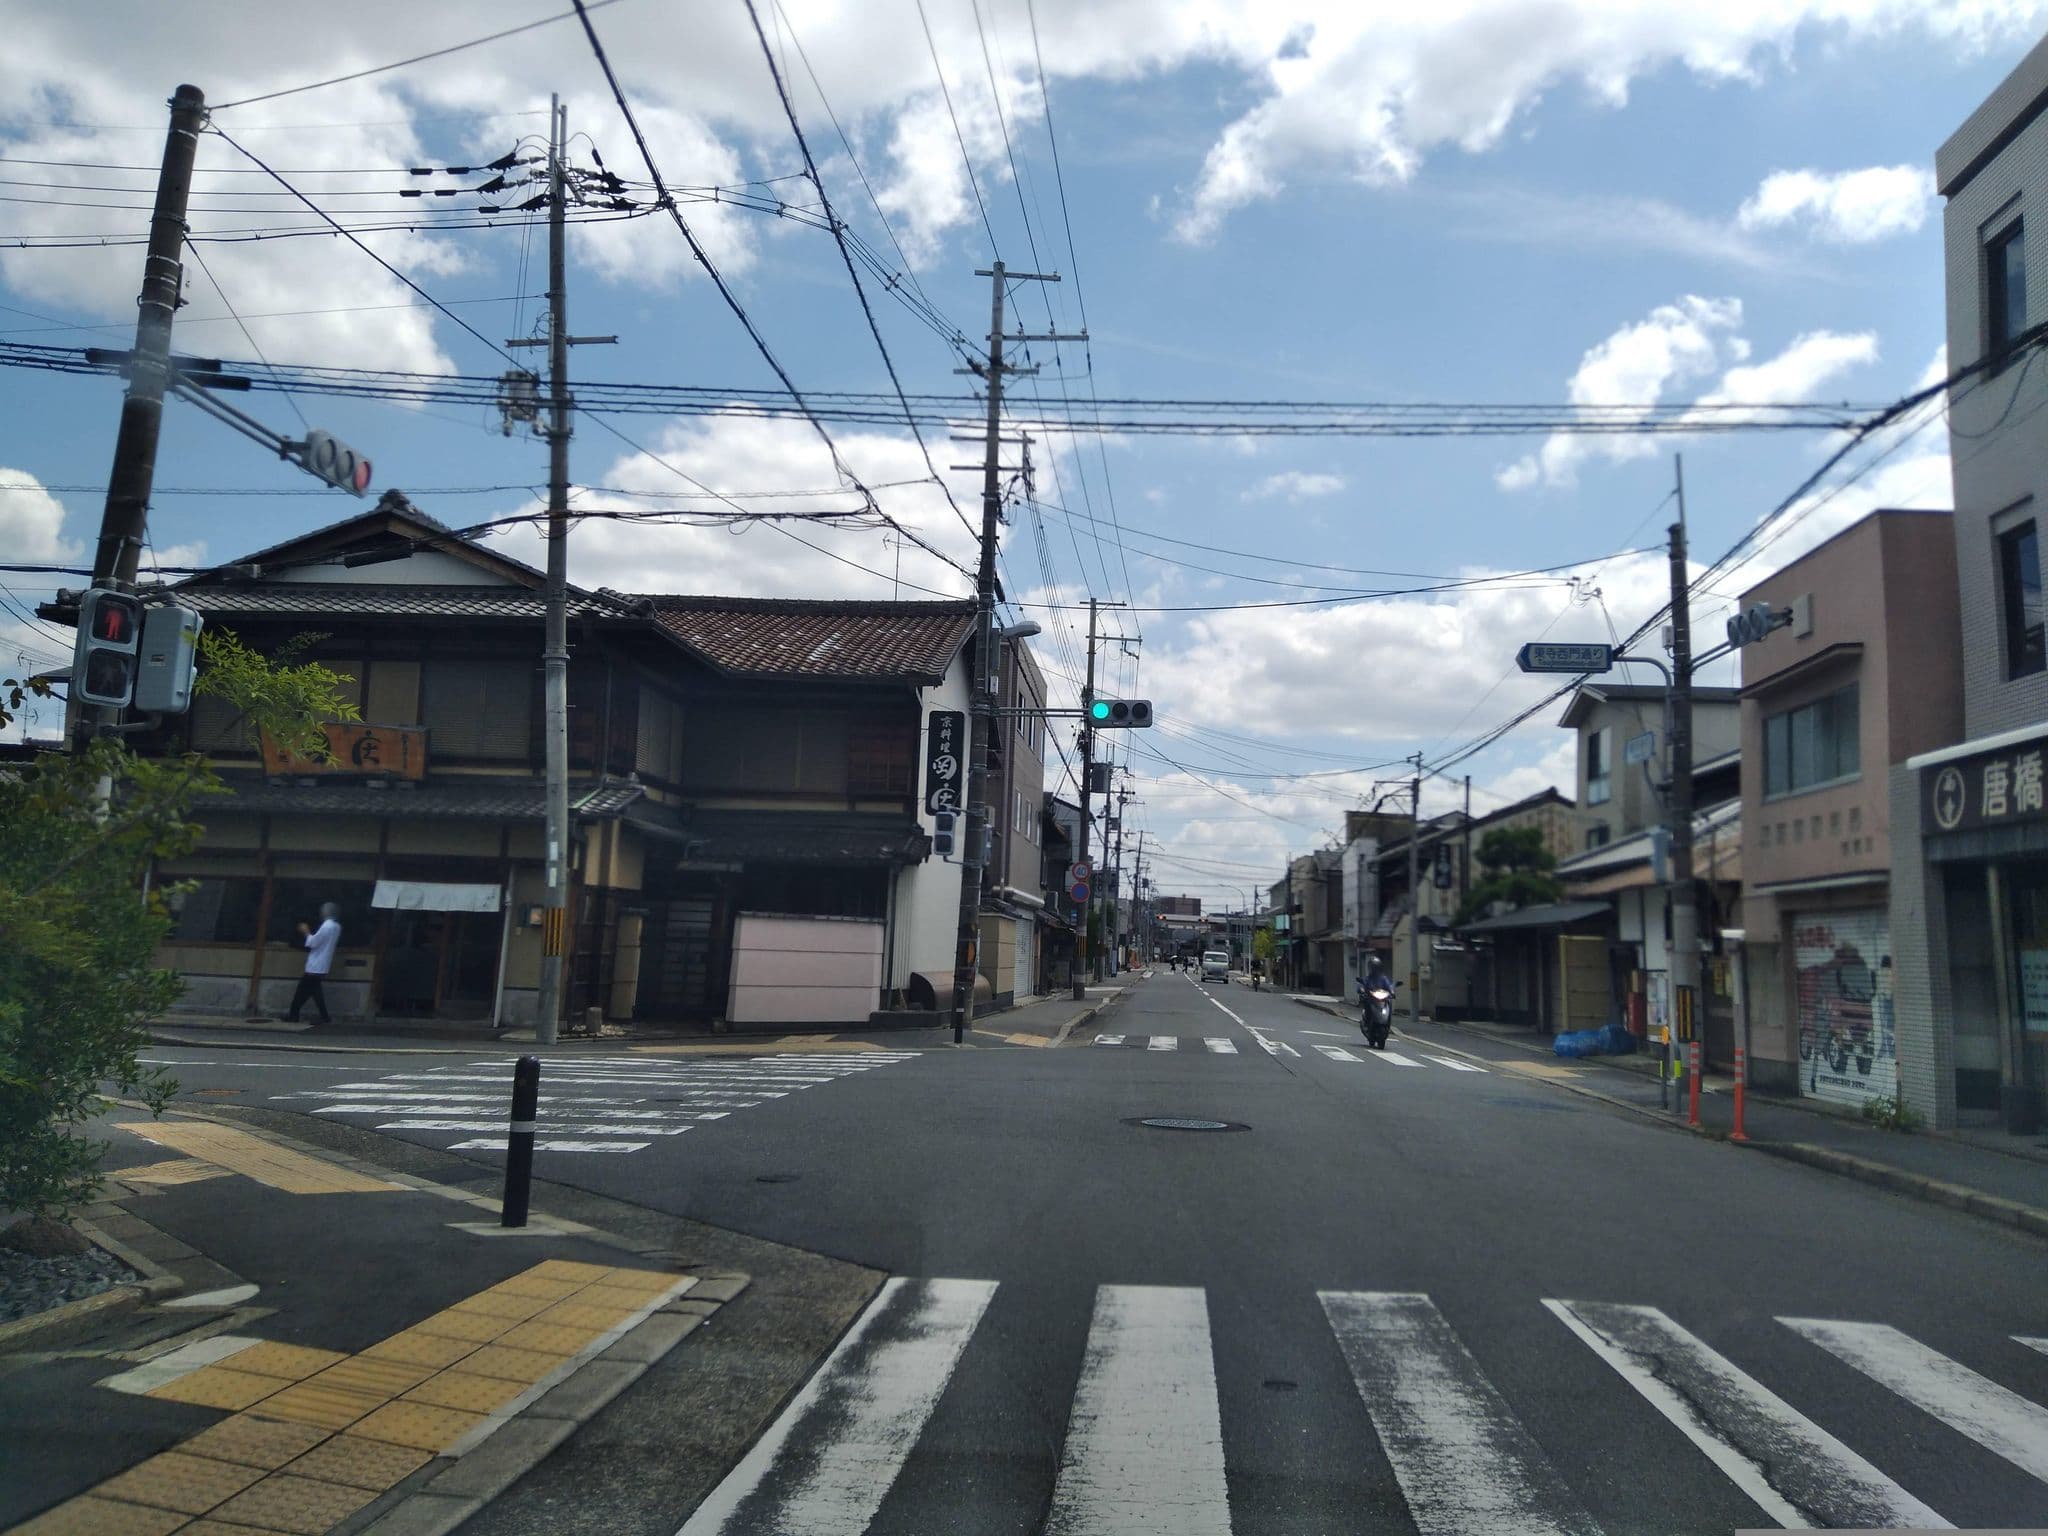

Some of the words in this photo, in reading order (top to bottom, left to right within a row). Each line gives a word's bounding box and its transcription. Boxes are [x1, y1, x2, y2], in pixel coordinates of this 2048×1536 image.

[1533, 647, 1603, 660] 東寺西門通り
[1981, 750, 2044, 817] 唐橋
[1076, 867, 1086, 877] 40
